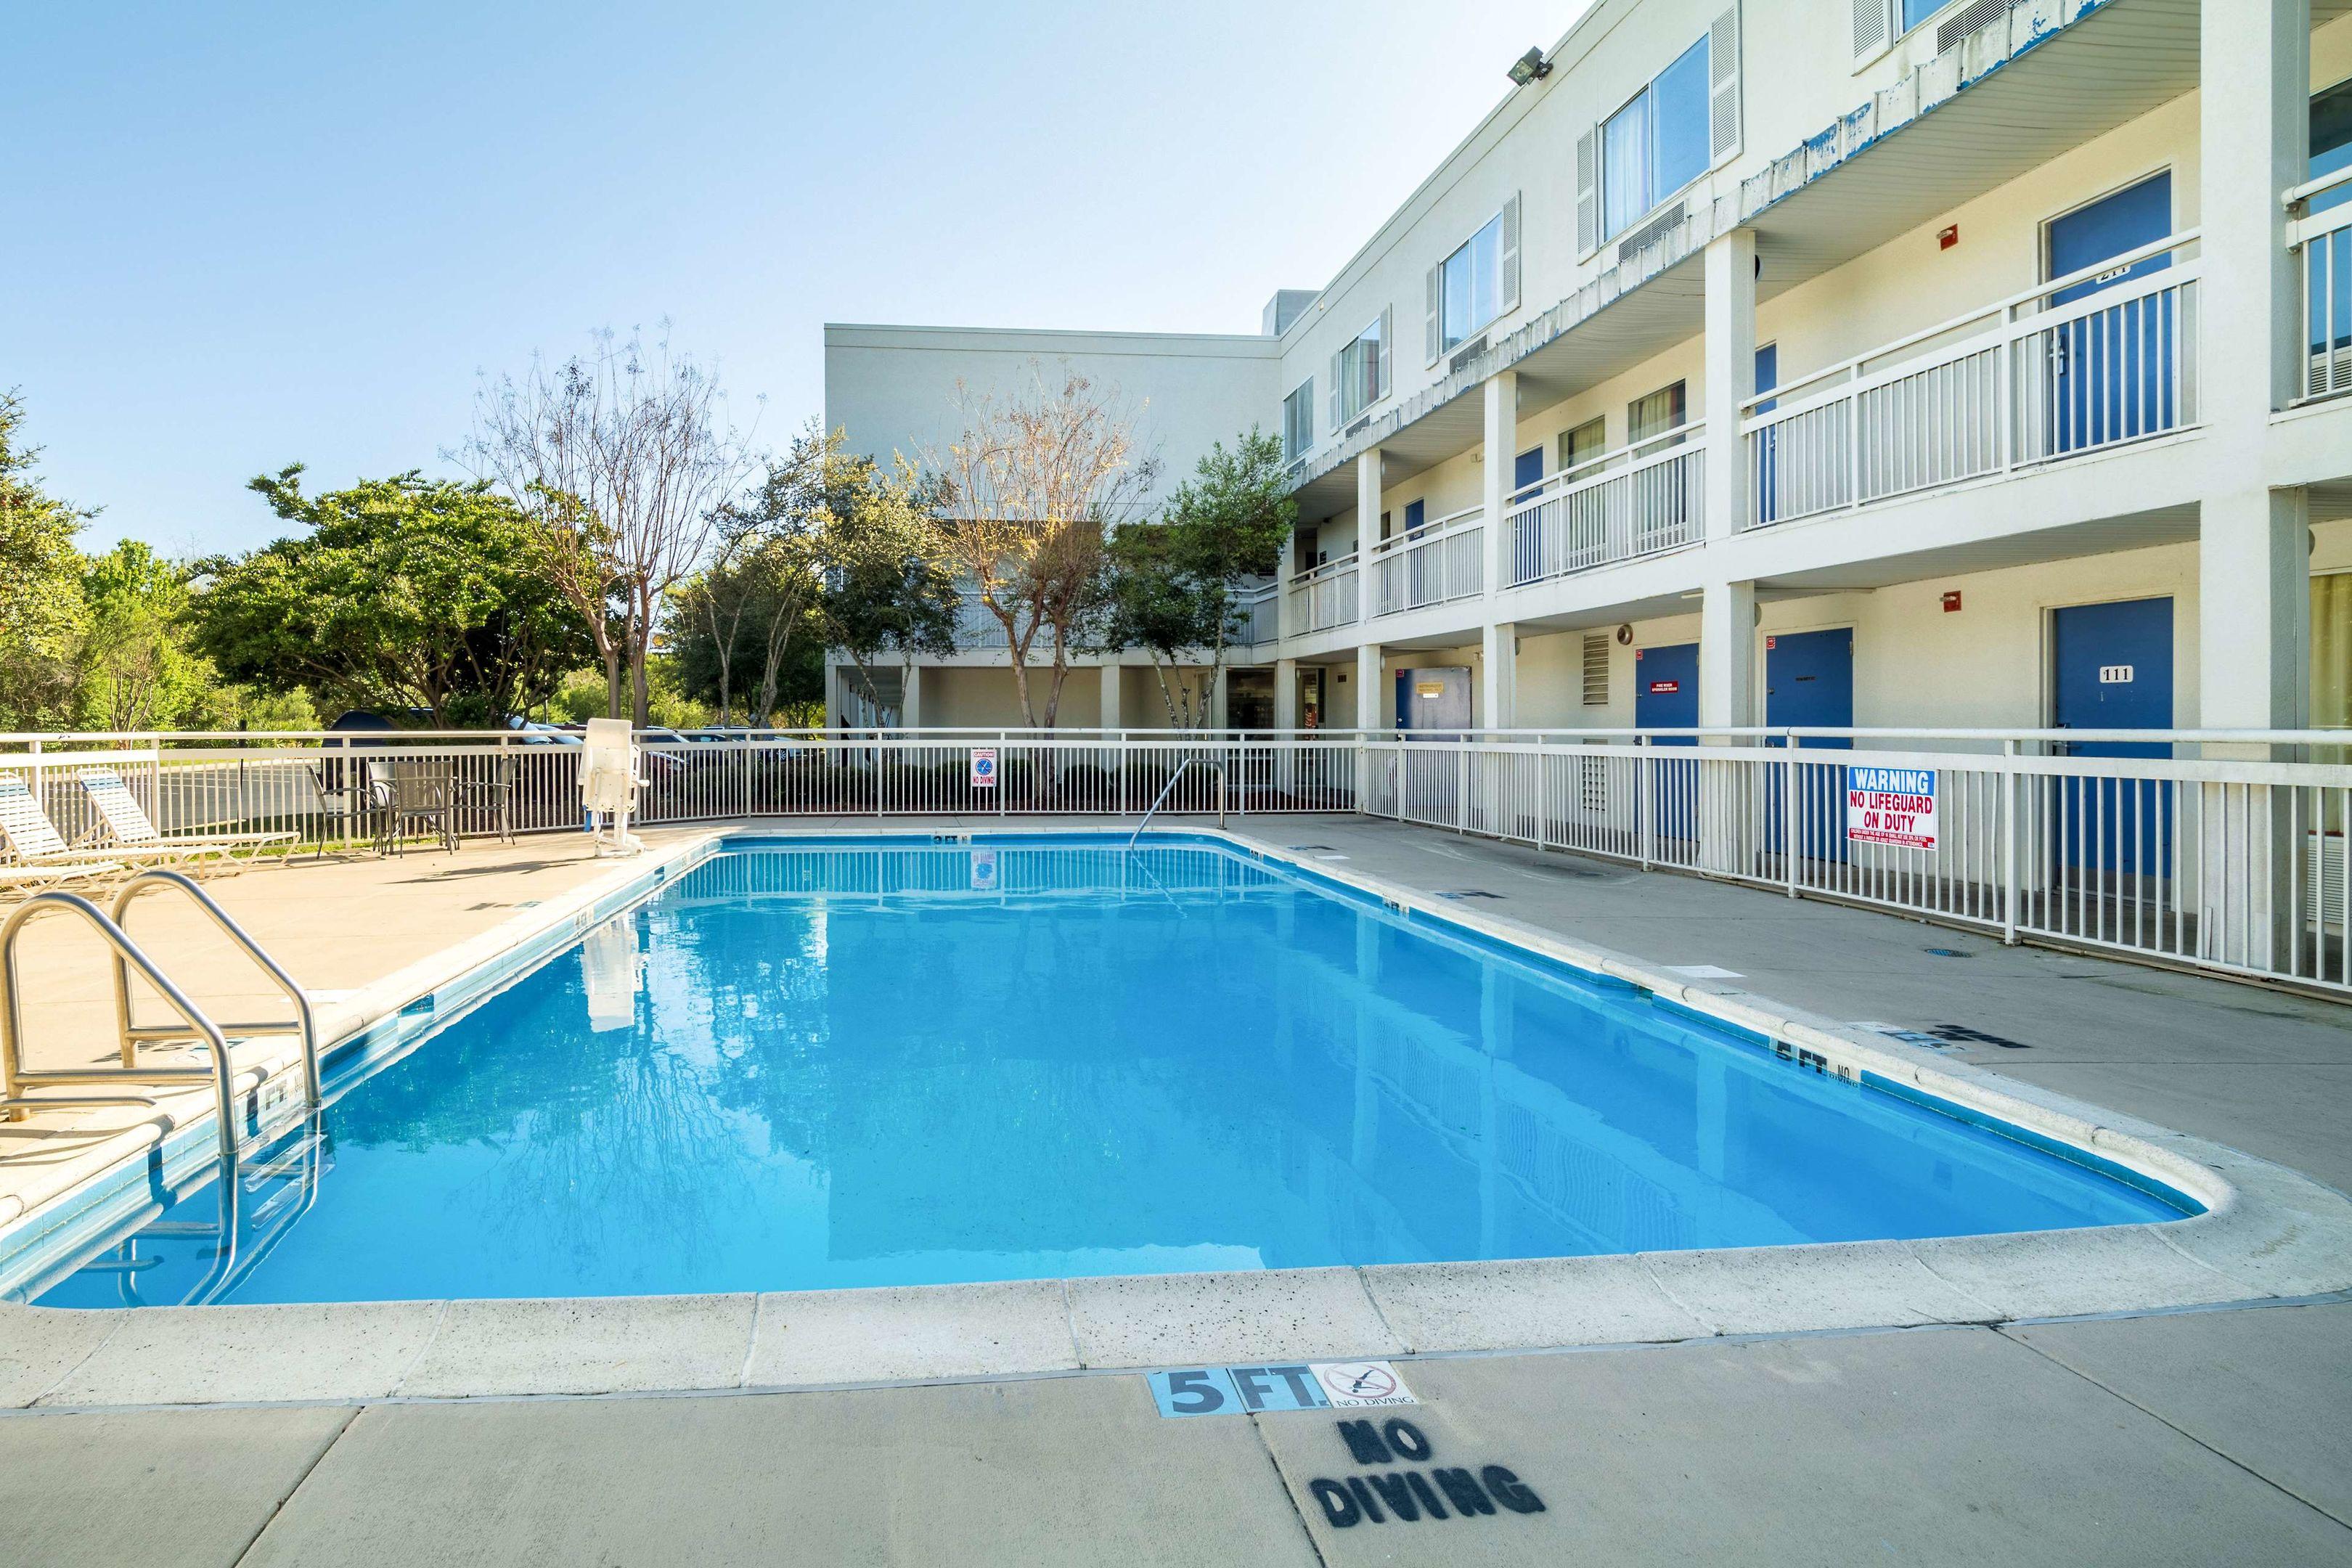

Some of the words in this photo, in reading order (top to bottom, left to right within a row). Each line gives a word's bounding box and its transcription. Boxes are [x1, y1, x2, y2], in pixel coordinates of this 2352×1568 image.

[2105, 668, 2128, 680] 111
[1854, 768, 1929, 794] WARNING
[1850, 791, 1864, 808] NO
[1869, 792, 1932, 814] LIFEGUARD
[1863, 811, 1879, 829] ON
[1885, 813, 1915, 833] DUTY
[1776, 1040, 1792, 1061] 5
[1837, 1064, 1849, 1079] NO
[1168, 1371, 1225, 1413] 5
[1364, 1396, 1414, 1406] DIVING
[1336, 1416, 1434, 1465] NO
[1310, 1464, 1547, 1529] DIVING
